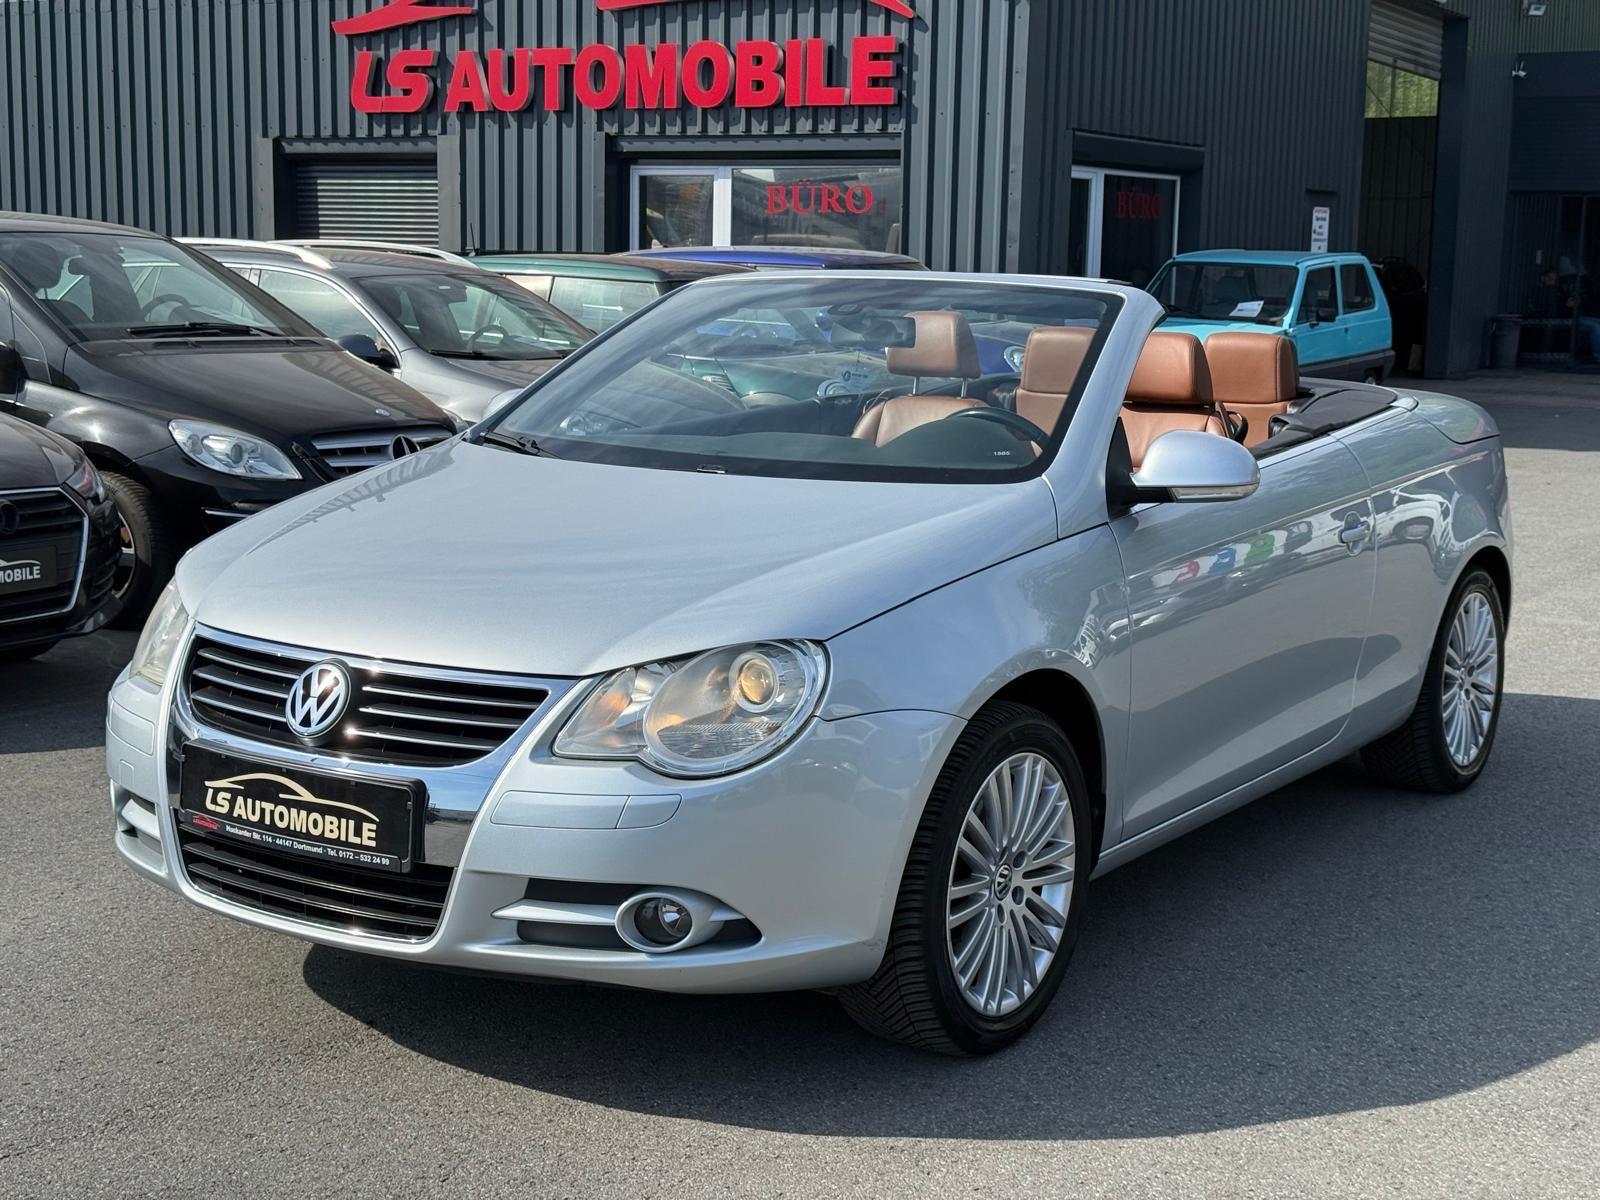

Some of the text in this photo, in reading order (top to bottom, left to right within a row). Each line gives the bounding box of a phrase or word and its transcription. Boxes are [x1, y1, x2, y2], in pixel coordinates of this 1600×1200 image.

[351, 36, 897, 113] LS AUTOMOBILE
[765, 180, 875, 215] BÜRO
[1115, 187, 1163, 219] BÜRO
[287, 662, 347, 734] VW
[204, 788, 377, 848] LS AUTOMOBILE
[262, 834, 272, 844] 114
[275, 837, 292, 848] 44147
[293, 840, 323, 854] Dortmund
[326, 848, 338, 857] Tel.
[338, 850, 354, 860] 0172
[359, 854, 372, 863] 532
[372, 856, 381, 864] 24
[381, 857, 390, 866] 99
